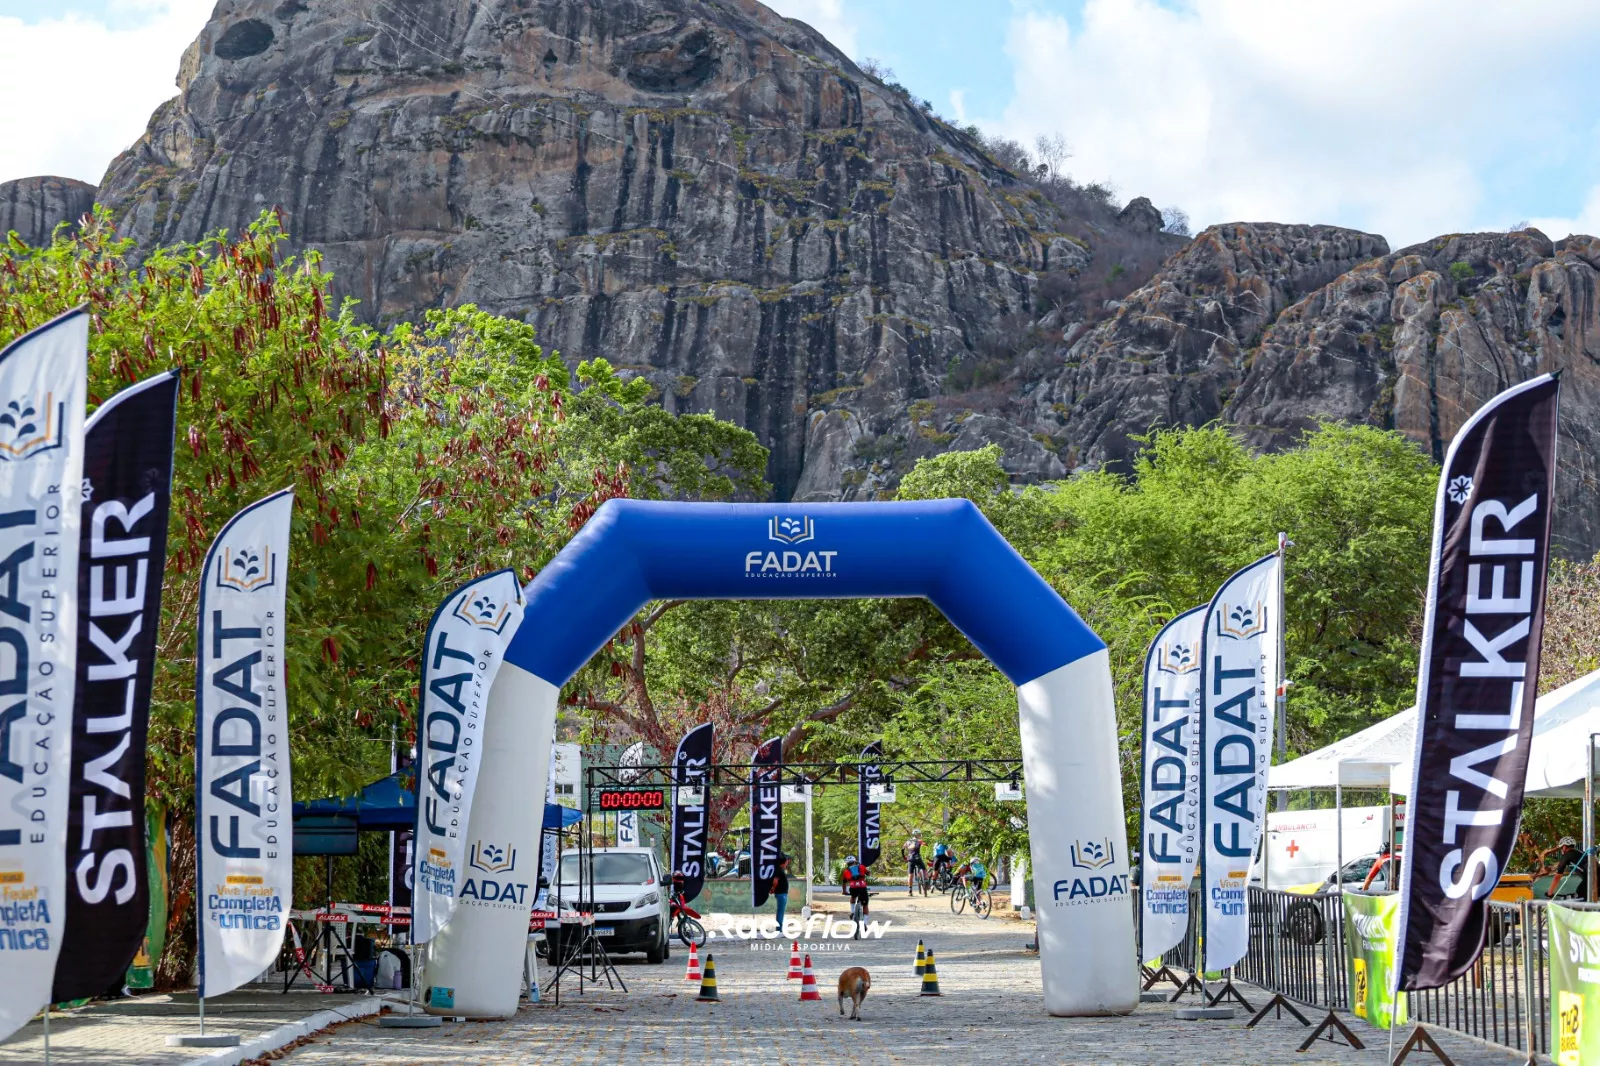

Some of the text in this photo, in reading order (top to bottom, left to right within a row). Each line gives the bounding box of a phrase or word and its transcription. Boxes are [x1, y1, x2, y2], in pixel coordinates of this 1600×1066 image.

[745, 551, 838, 572] FADAT
[30, 483, 60, 844] EDUCAÇÃO SUPERIOR
[76, 492, 155, 905] STALKER
[210, 609, 262, 859] FADAT
[267, 610, 279, 859] EDUCAÇÃO SUPERIOR
[425, 631, 476, 837] FADAT
[467, 649, 493, 729] SUPERIOR
[1260, 654, 1268, 745] SUPERIOR
[1439, 493, 1538, 900] STALKER
[601, 791, 663, 808] 00:00:00
[1149, 687, 1190, 864] FADAT
[1186, 687, 1201, 863] EDUCAÇÃO SUPERIOR
[1213, 655, 1256, 858] FADAT
[459, 878, 529, 905] ADAT
[459, 899, 490, 907] CAÇÃO
[1053, 874, 1129, 901] FADAT
